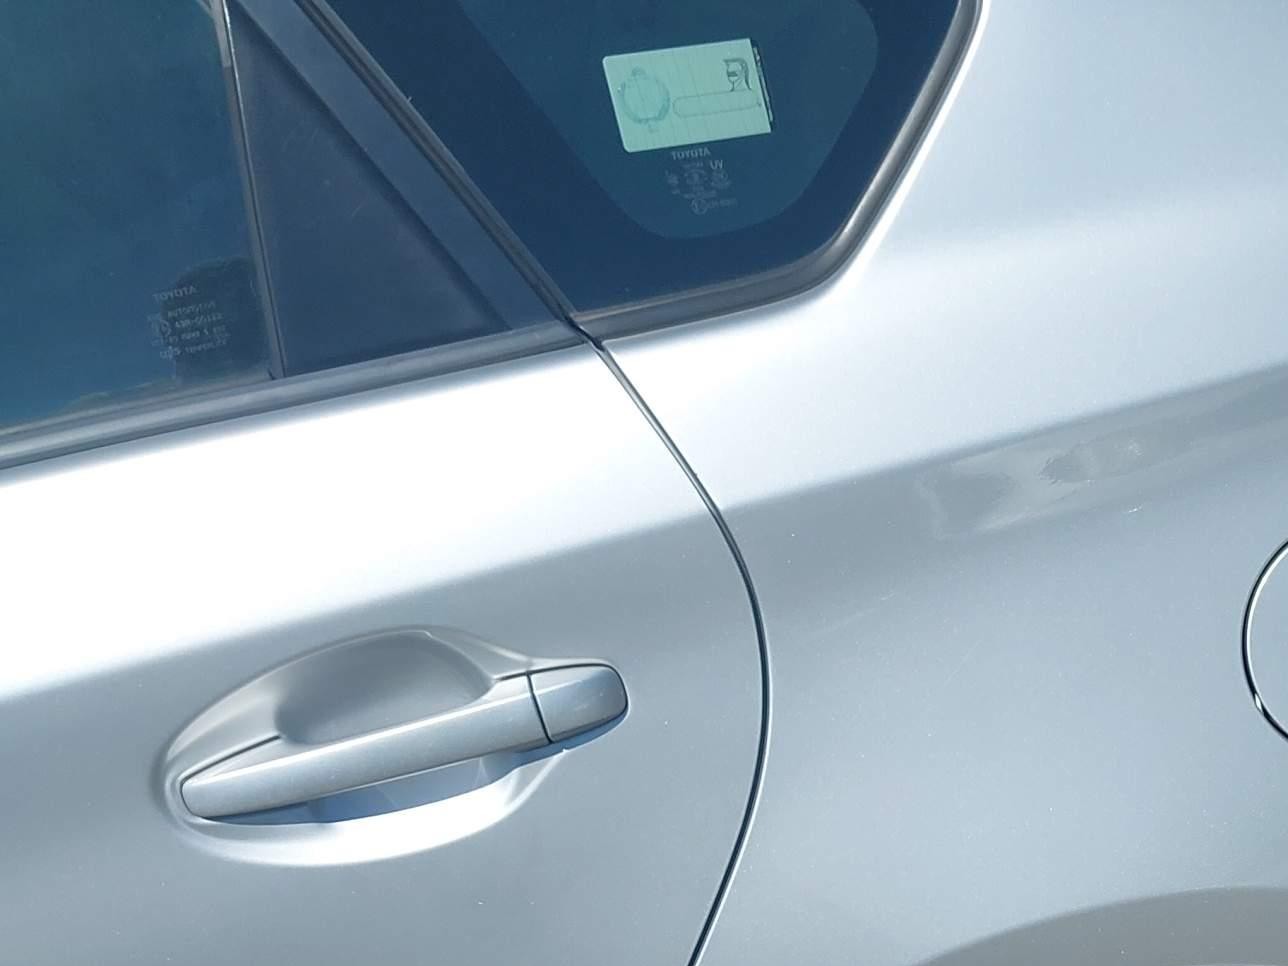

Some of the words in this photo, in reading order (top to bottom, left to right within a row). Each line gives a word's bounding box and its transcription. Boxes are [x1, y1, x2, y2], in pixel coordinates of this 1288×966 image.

[672, 148, 711, 161] TOYOTA
[709, 159, 724, 170] UV
[153, 286, 198, 304] TOYOTA
